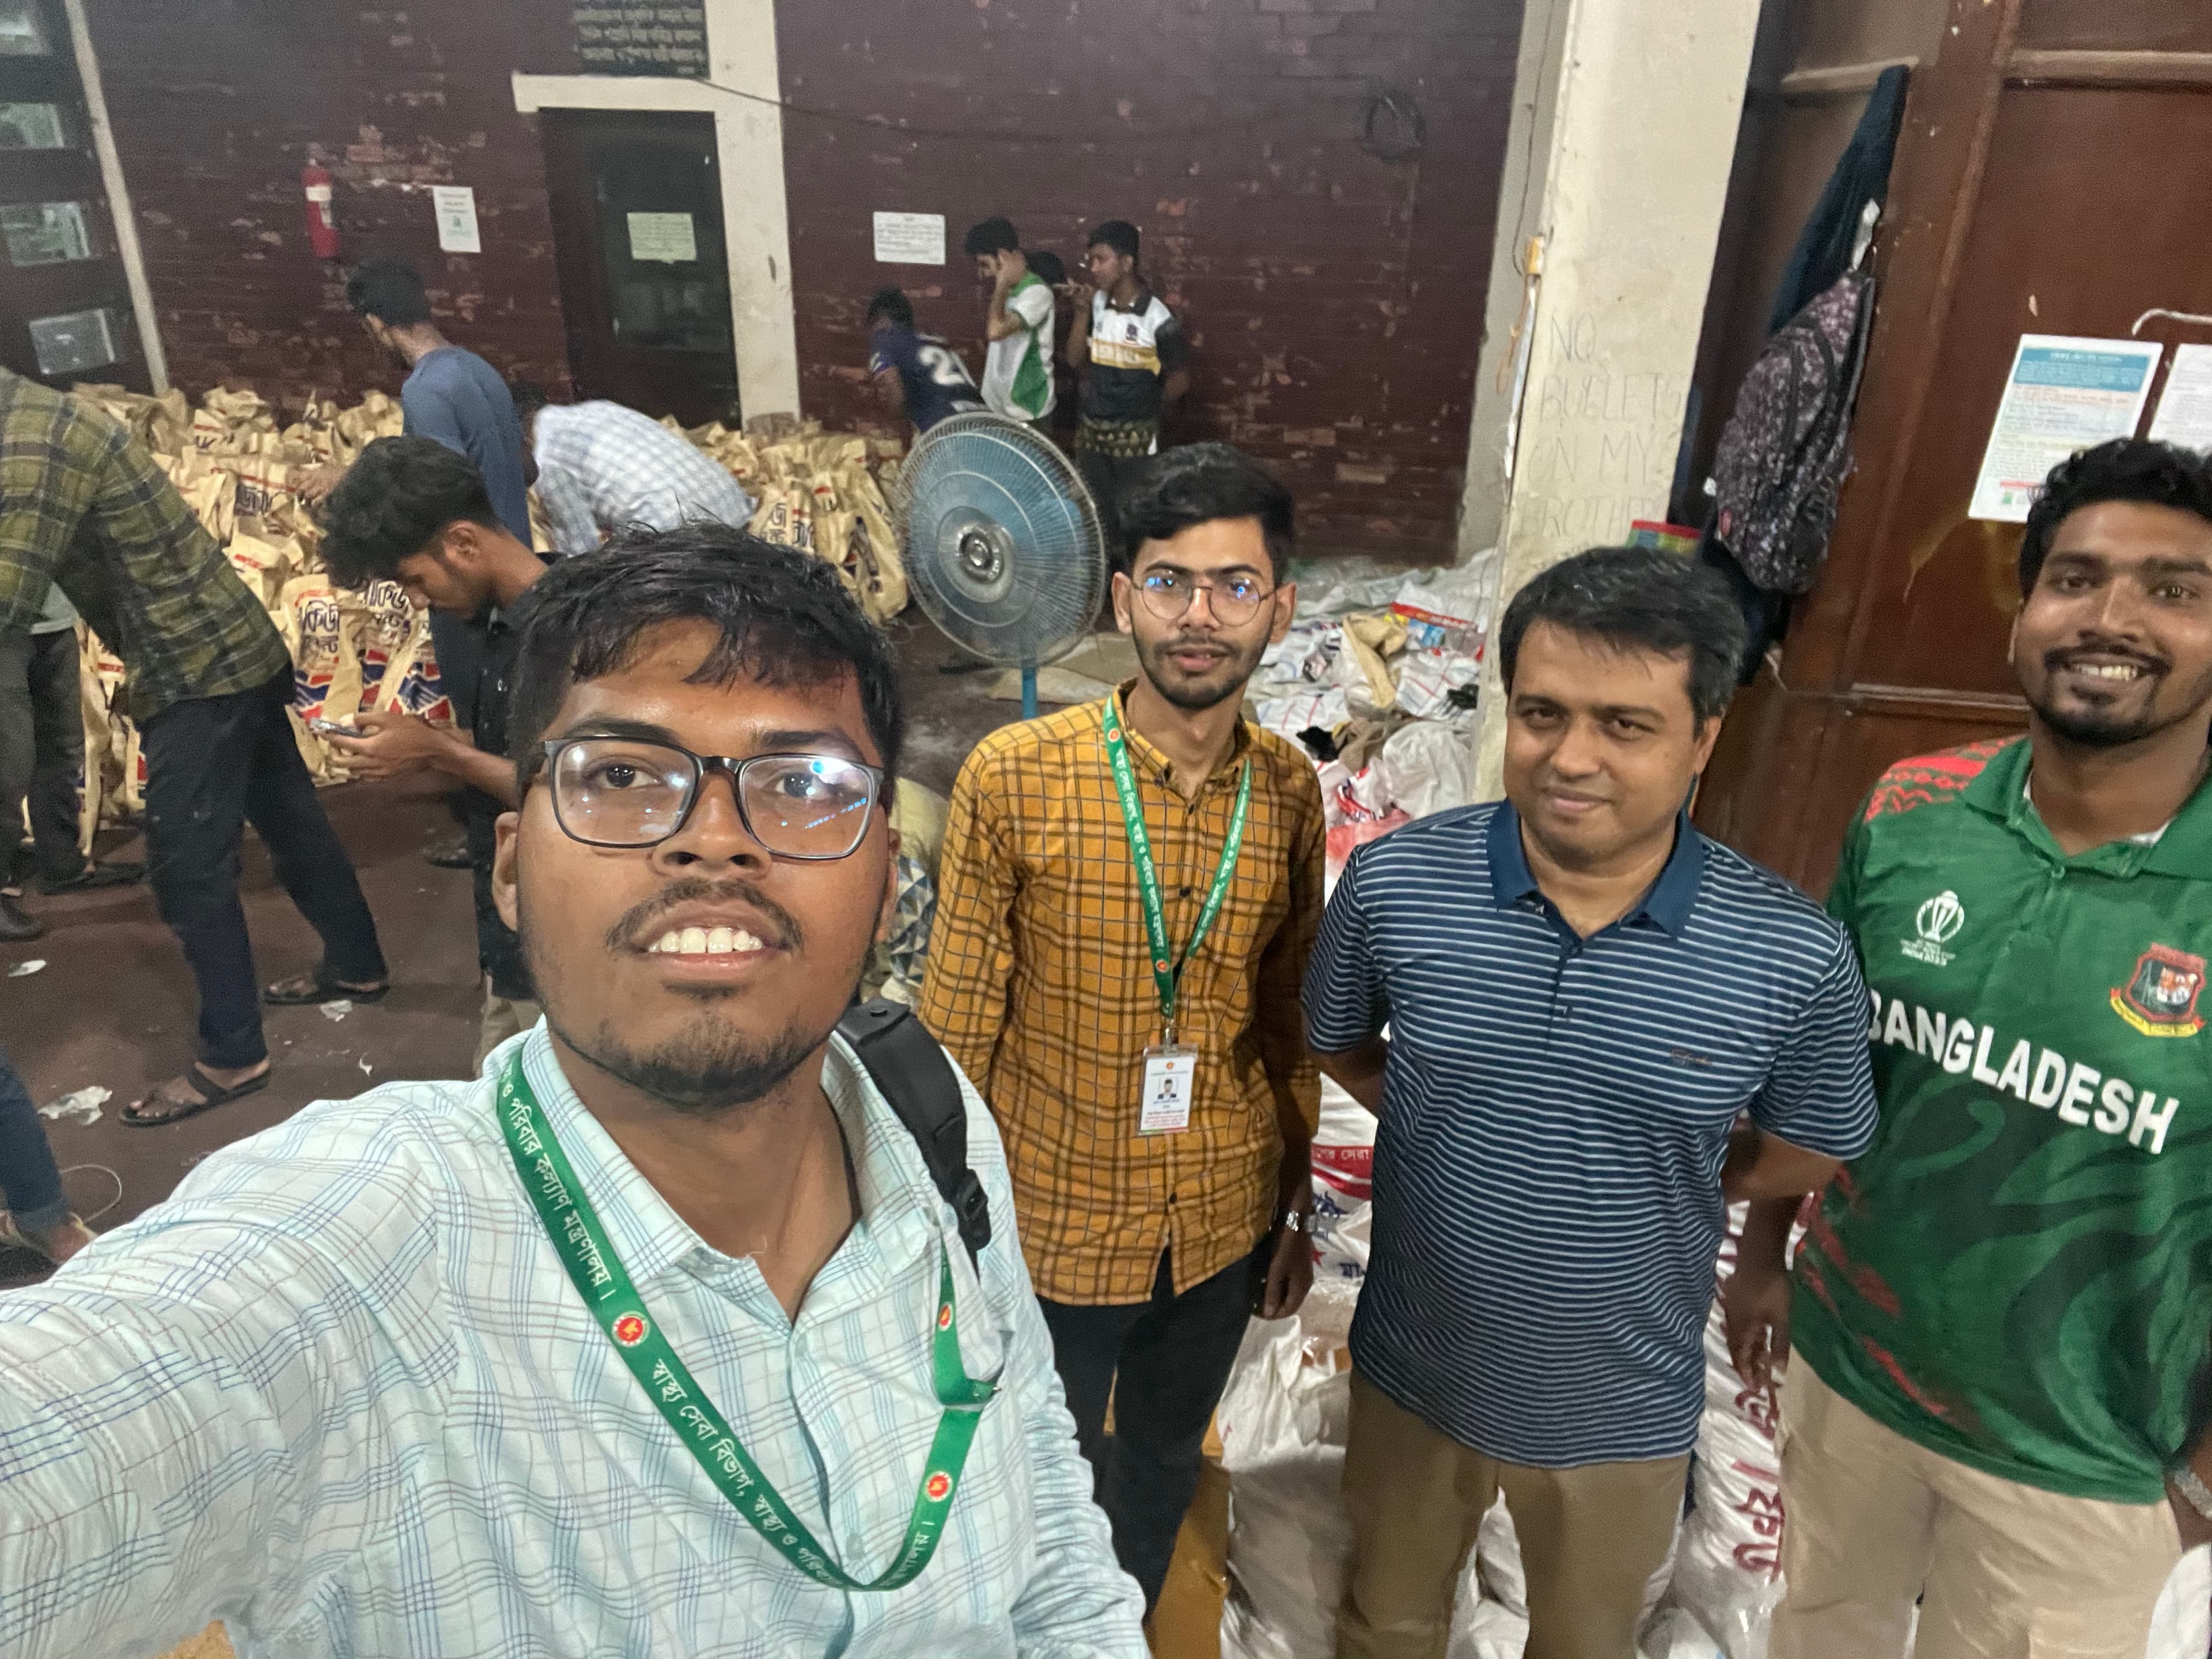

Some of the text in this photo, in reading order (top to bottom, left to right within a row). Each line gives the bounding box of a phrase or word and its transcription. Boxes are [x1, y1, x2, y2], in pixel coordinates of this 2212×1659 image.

[1597, 430, 1657, 485] MY
[509, 1097, 543, 1156] পরিবার
[534, 1152, 574, 1211] কল্যাণ
[680, 1405, 718, 1441] সেবা
